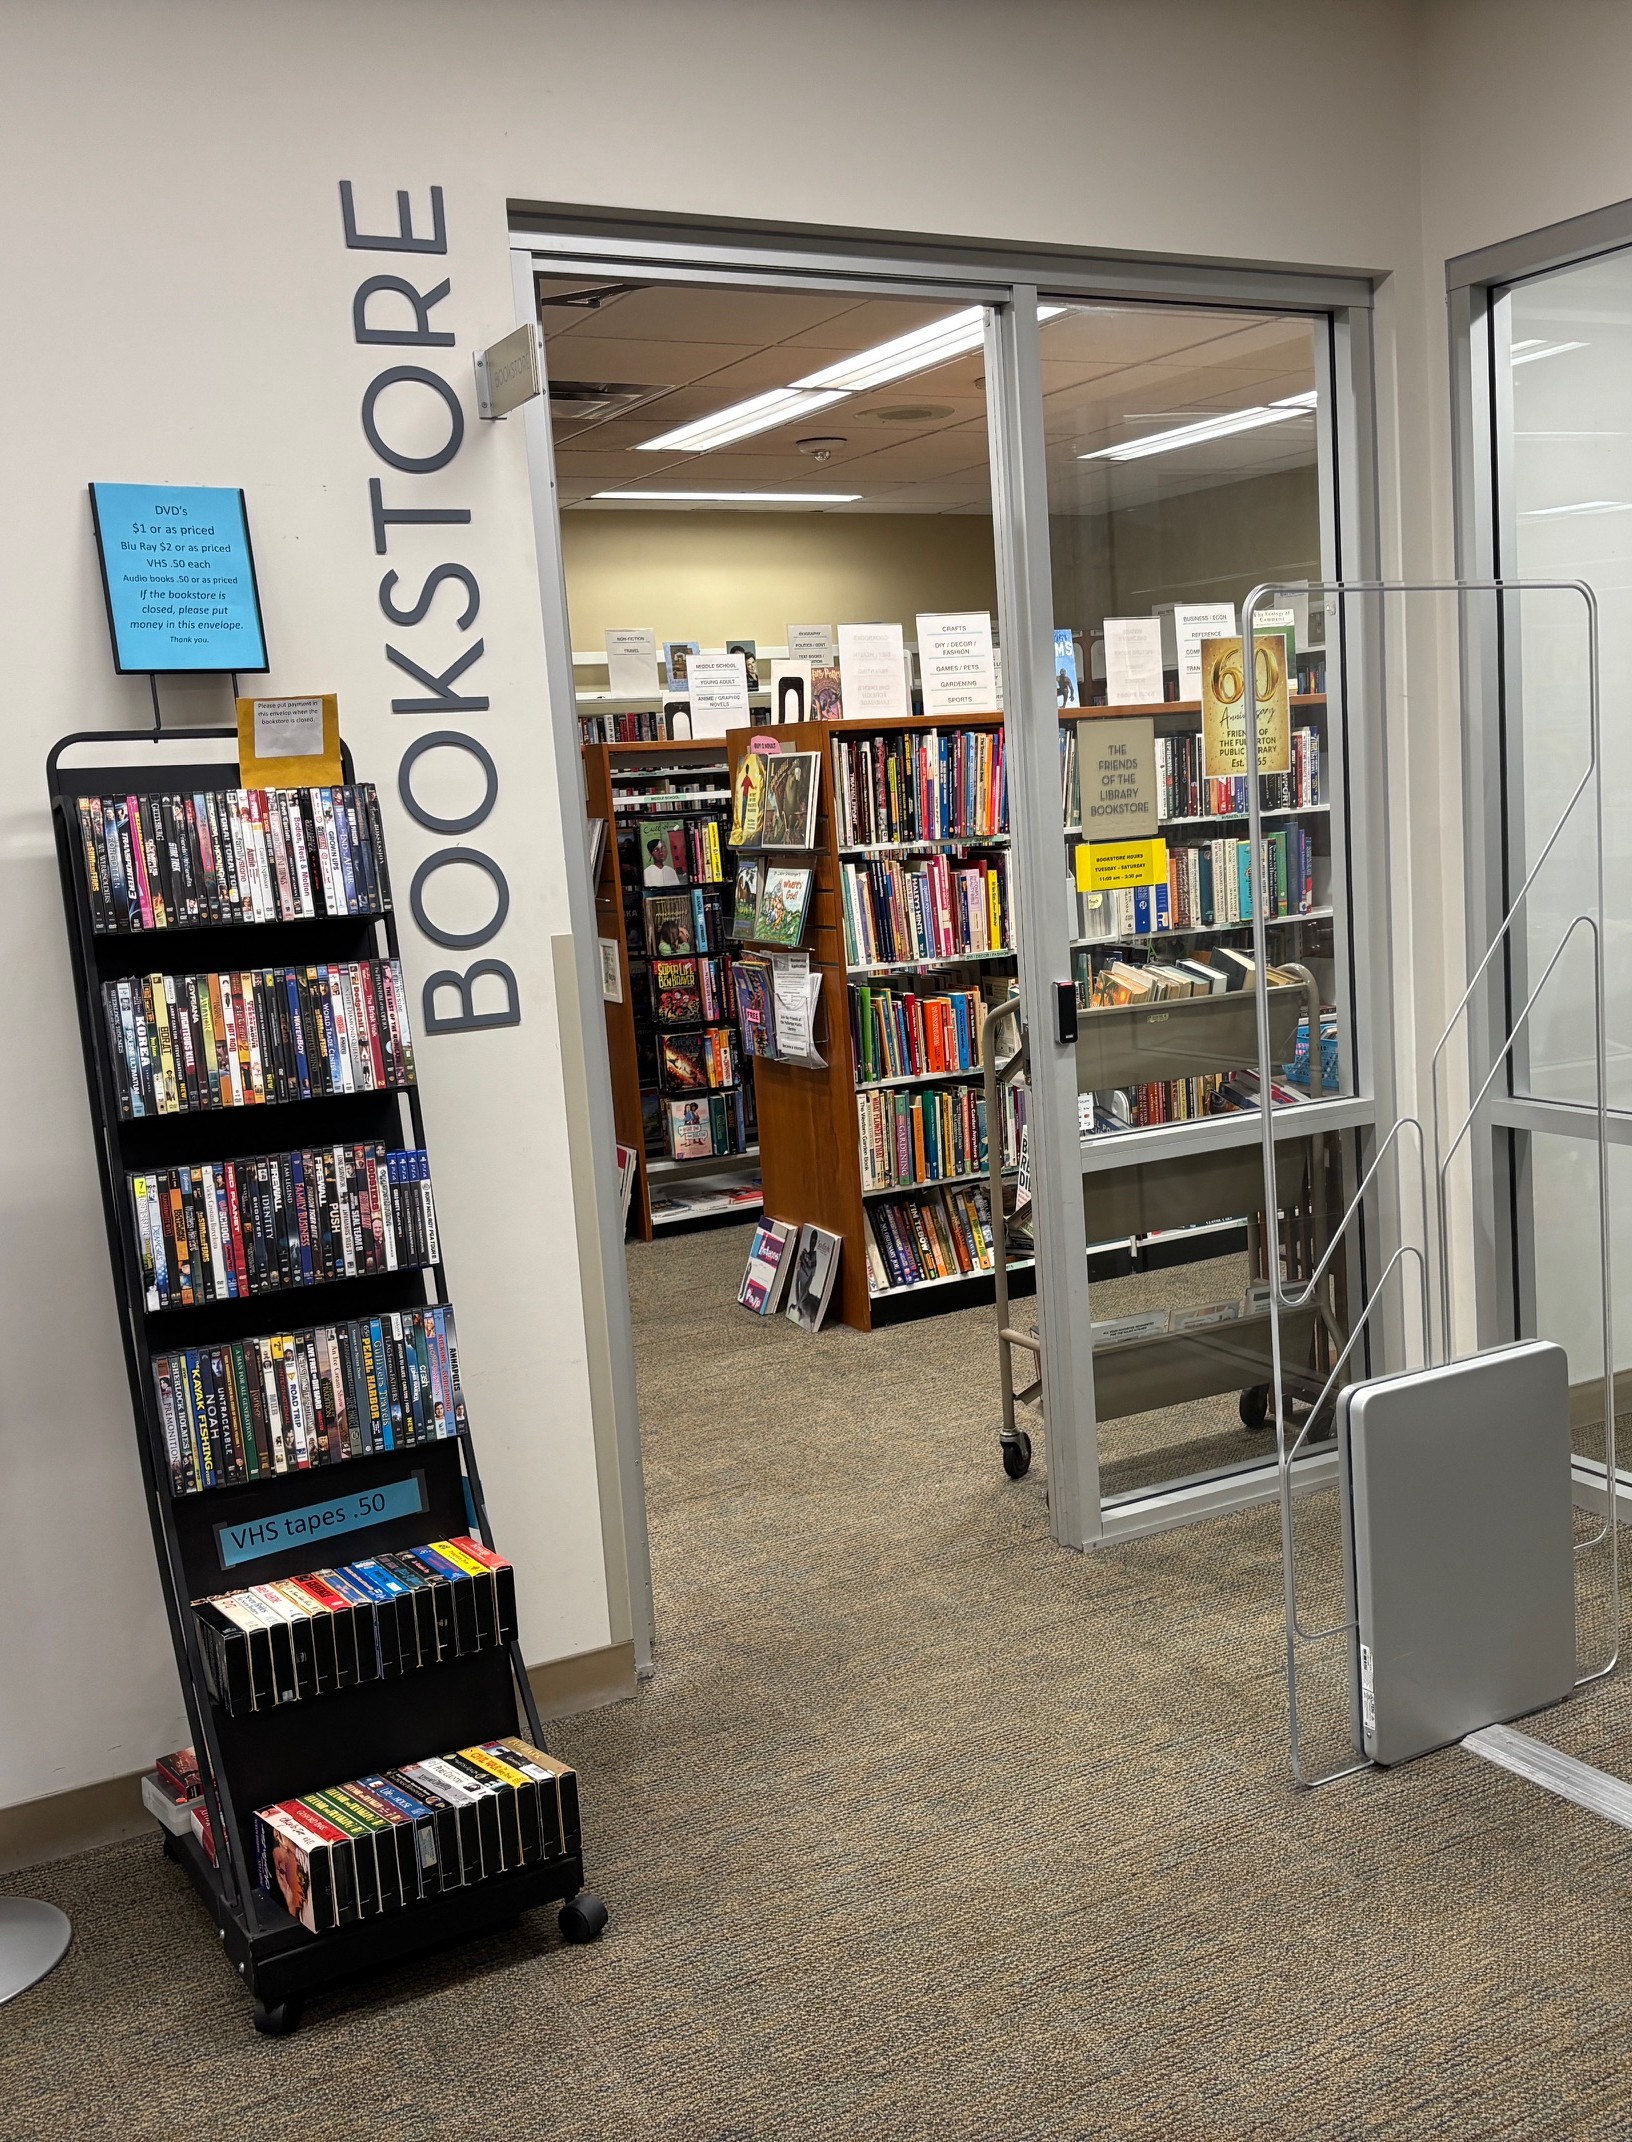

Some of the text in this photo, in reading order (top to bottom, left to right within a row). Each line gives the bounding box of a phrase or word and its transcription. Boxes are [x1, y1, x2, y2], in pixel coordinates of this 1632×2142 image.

[155, 505, 188, 516] DVD's
[121, 541, 137, 551] Blu
[140, 542, 157, 553] Ray
[160, 542, 172, 552] $2
[201, 544, 231, 553] priced
[132, 522, 215, 536] $1 or as priced
[123, 574, 147, 583] Audio
[149, 575, 174, 583] books
[177, 575, 189, 583] .50
[191, 576, 200, 584] or
[213, 576, 238, 585] priced
[146, 559, 211, 569] VHS .50 each
[140, 589, 226, 600] If the bookstore is
[142, 604, 228, 616] closed, please put
[339, 179, 521, 1035] BOOKSTORE
[130, 620, 244, 631] money in this envelope.
[1183, 615, 1209, 623] BUSINESS
[940, 680, 977, 688] GARDENING
[1108, 744, 1127, 756] THE
[1259, 728, 1269, 736] OF
[1098, 758, 1138, 772] FRIENDS
[1219, 748, 1245, 757] PUBLIC
[1231, 759, 1244, 768] Est.
[1100, 788, 1139, 801] LIBRARY
[1102, 773, 1136, 786] OF THE
[1090, 801, 1149, 817] BOOKSTORE
[121, 831, 138, 901] TRANSPORTER 3
[746, 1011, 759, 1020] FREE
[135, 1015, 151, 1068] KOREA
[158, 1025, 172, 1056] BORAT
[322, 1003, 338, 1072] WORLD TRADE CENTER
[898, 1125, 909, 1176] GARDENING
[226, 1166, 241, 1233] RED PLANET
[268, 1161, 284, 1213] FIREWALL
[312, 1156, 328, 1208] FIREWALL
[365, 1159, 381, 1211] HOOSIERS
[260, 1194, 274, 1240] IDENTITY
[294, 1182, 311, 1247] FAMILY BUSINESS
[328, 1202, 342, 1234] PUSH
[351, 1210, 363, 1246] SEAL TEAM
[909, 1202, 929, 1252] TIM TEBOW
[306, 1343, 323, 1410] LIVE FREE DIE HARD
[361, 1337, 381, 1420] PEARL HARBOR
[418, 1364, 430, 1388] crash
[448, 1347, 462, 1392] ANNAPOLIS
[171, 1361, 191, 1450] SHERLOCK HOLMES
[191, 1368, 214, 1472] KAYAK FISHING
[205, 1393, 220, 1440] NOAH
[216, 1387, 233, 1455] UNTRACEABLE
[289, 1383, 302, 1428] ROAD TRIP
[163, 1402, 180, 1464] PREMONITION
[230, 1493, 386, 1549] VHS tapes .50
